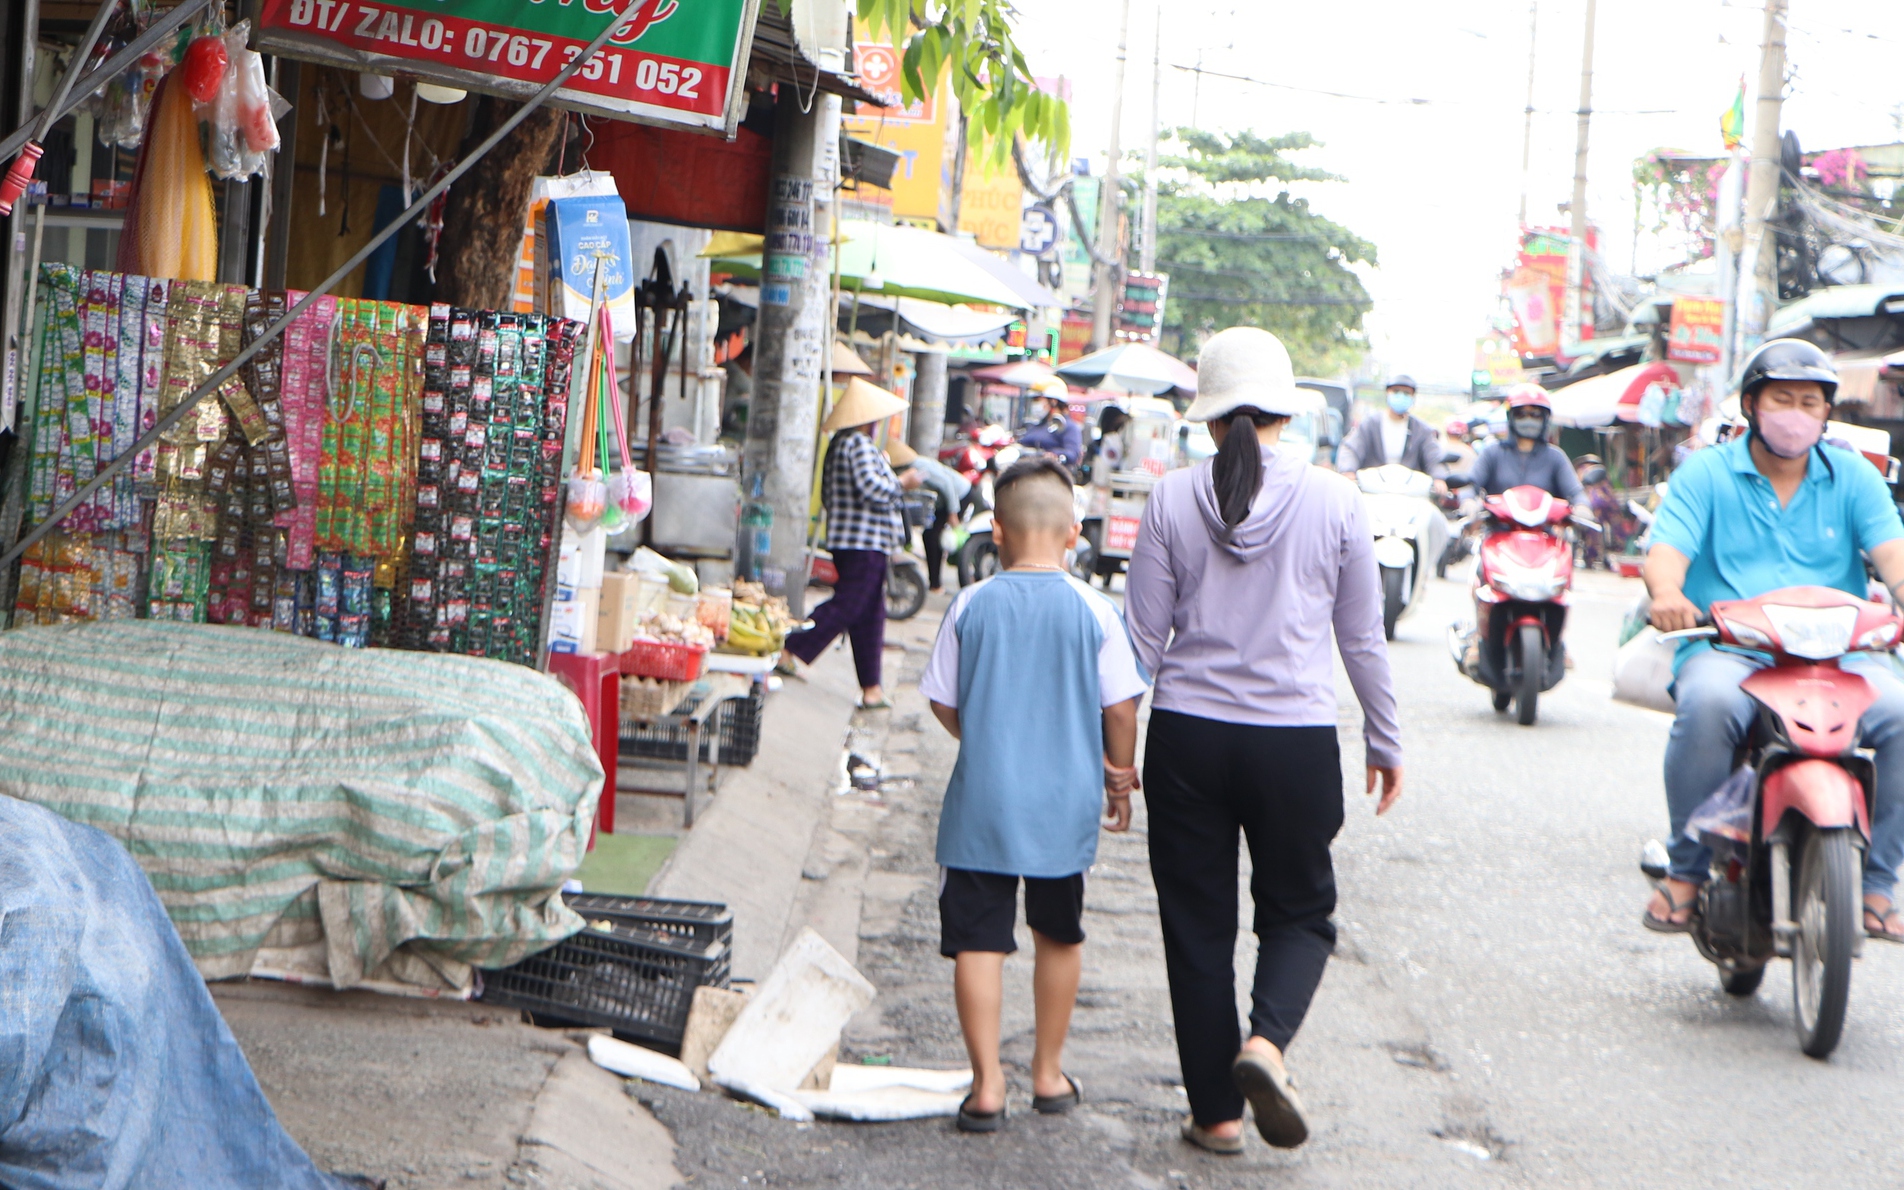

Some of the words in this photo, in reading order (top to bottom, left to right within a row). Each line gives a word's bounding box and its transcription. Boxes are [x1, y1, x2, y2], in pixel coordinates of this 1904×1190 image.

[289, 0, 350, 31] ĐT/
[354, 5, 454, 53] ZALO:
[464, 27, 552, 70] 0767
[561, 45, 623, 84] 351
[636, 59, 702, 99] 052
[578, 241, 595, 250] CAO
